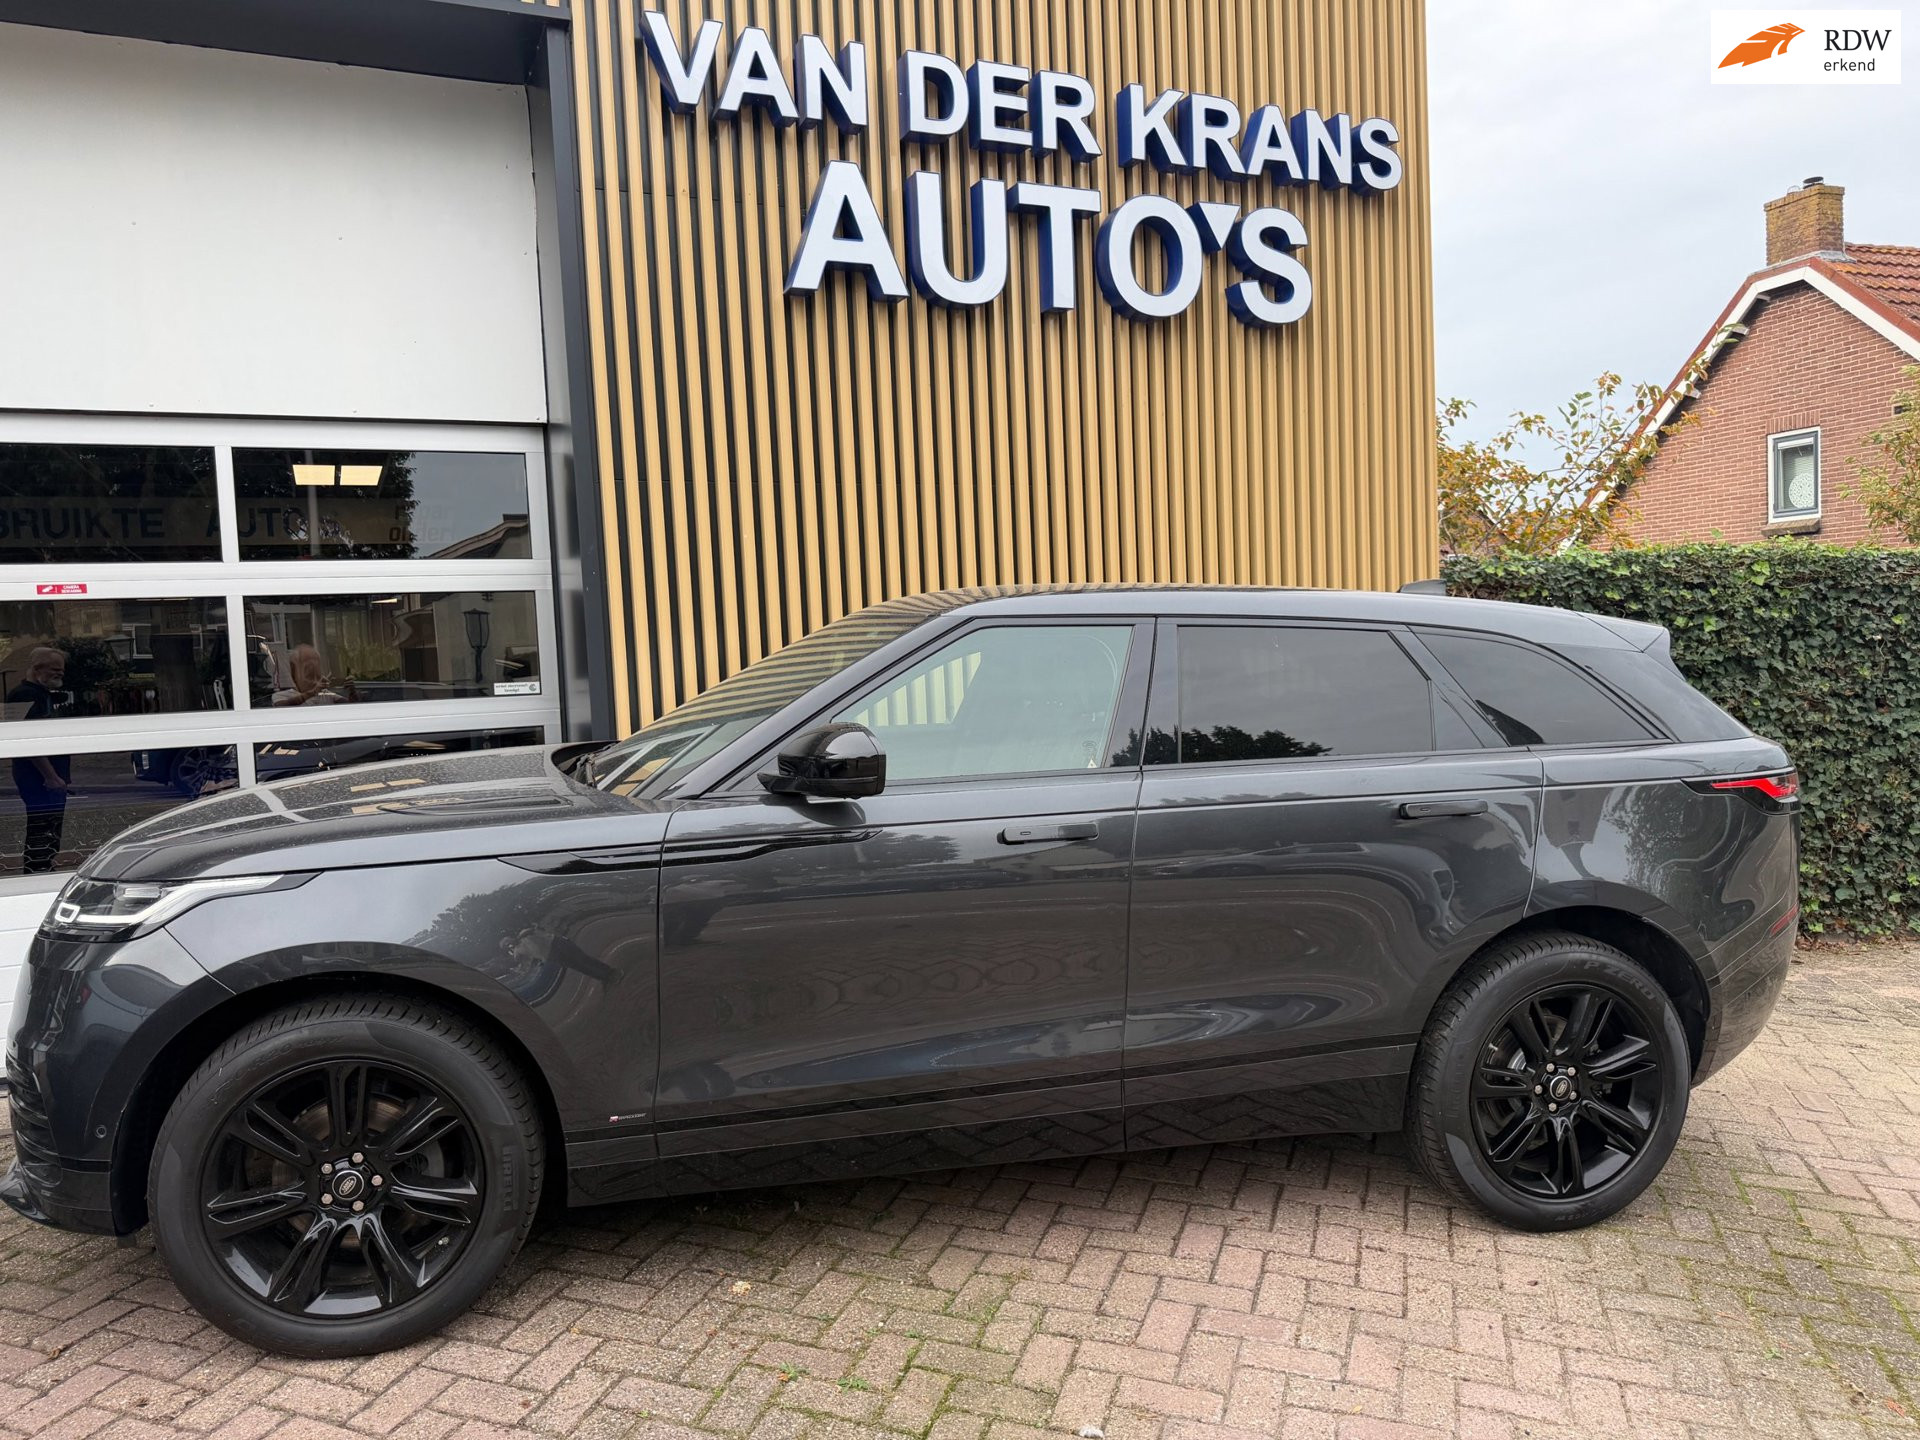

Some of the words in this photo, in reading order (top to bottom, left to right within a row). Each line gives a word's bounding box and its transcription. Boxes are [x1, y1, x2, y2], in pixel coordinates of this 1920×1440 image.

[641, 10, 870, 136] VAN
[897, 48, 1103, 164] DER
[1115, 81, 1404, 197] KRANS
[784, 159, 1314, 330] AUTO'S
[1604, 965, 1656, 1000] ZERO
